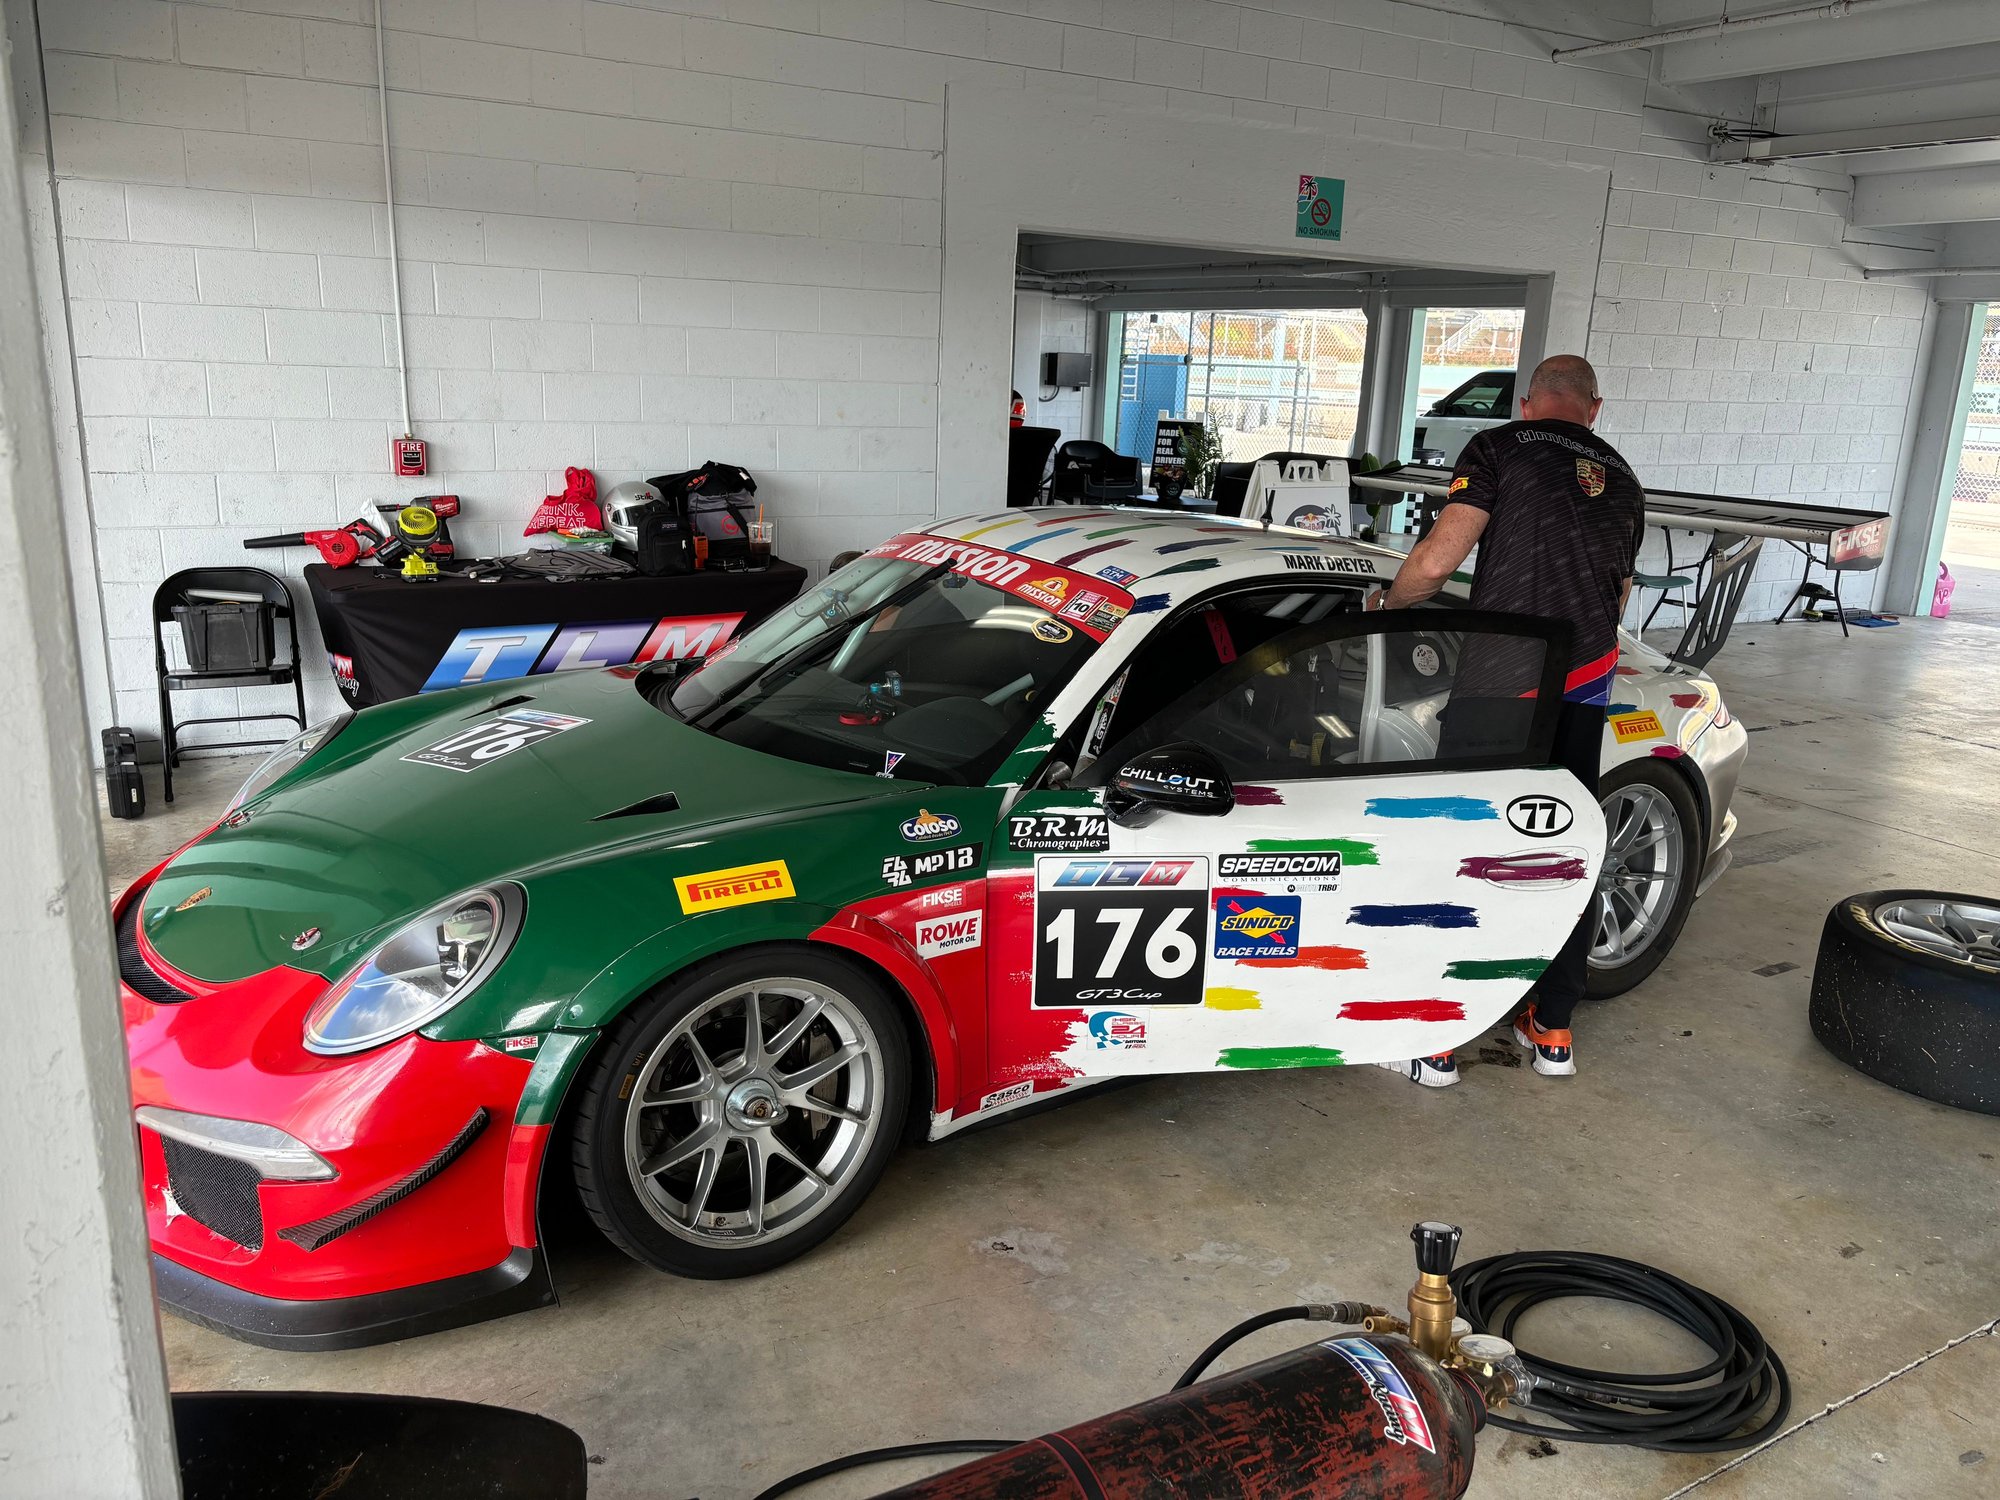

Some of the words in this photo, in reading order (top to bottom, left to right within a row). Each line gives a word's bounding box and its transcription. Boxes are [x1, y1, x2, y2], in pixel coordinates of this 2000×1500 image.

[1298, 226, 1308, 234] NO
[1309, 227, 1340, 238] SMOKING
[1157, 438, 1172, 446] FOR
[1158, 428, 1180, 437] MADE
[400, 443, 422, 451] FIRE
[1156, 447, 1174, 456] REAL
[1154, 456, 1187, 465] DRIVERS
[1837, 524, 1882, 552] FIKSE
[1102, 567, 1125, 580] GTM
[1282, 554, 1325, 571] MARK
[1324, 556, 1376, 574] DREYER
[1072, 602, 1091, 613] 10
[456, 622, 725, 684] TLM
[1616, 716, 1660, 736] PIRELLI
[430, 721, 553, 760] 176
[1120, 766, 1215, 790] CHILLOUT
[1519, 802, 1557, 830] 77
[902, 819, 958, 838] Coloso
[1017, 837, 1101, 850] Chronographes
[1069, 864, 1184, 883] TLM
[687, 869, 783, 902] PIRELLI
[922, 888, 963, 907] FIKSE
[920, 917, 978, 946] ROWE
[1224, 916, 1290, 929] SUNOCO
[939, 938, 964, 948] MOTOR
[965, 934, 977, 943] OIL
[1045, 907, 1197, 979] 176
[1216, 946, 1254, 957] RACE
[1254, 946, 1297, 957] FUELS
[1111, 1025, 1146, 1038] 24
[506, 1037, 537, 1049] FIKSE
[985, 1084, 1030, 1109] Sasco
[1370, 1380, 1405, 1443] Racing
